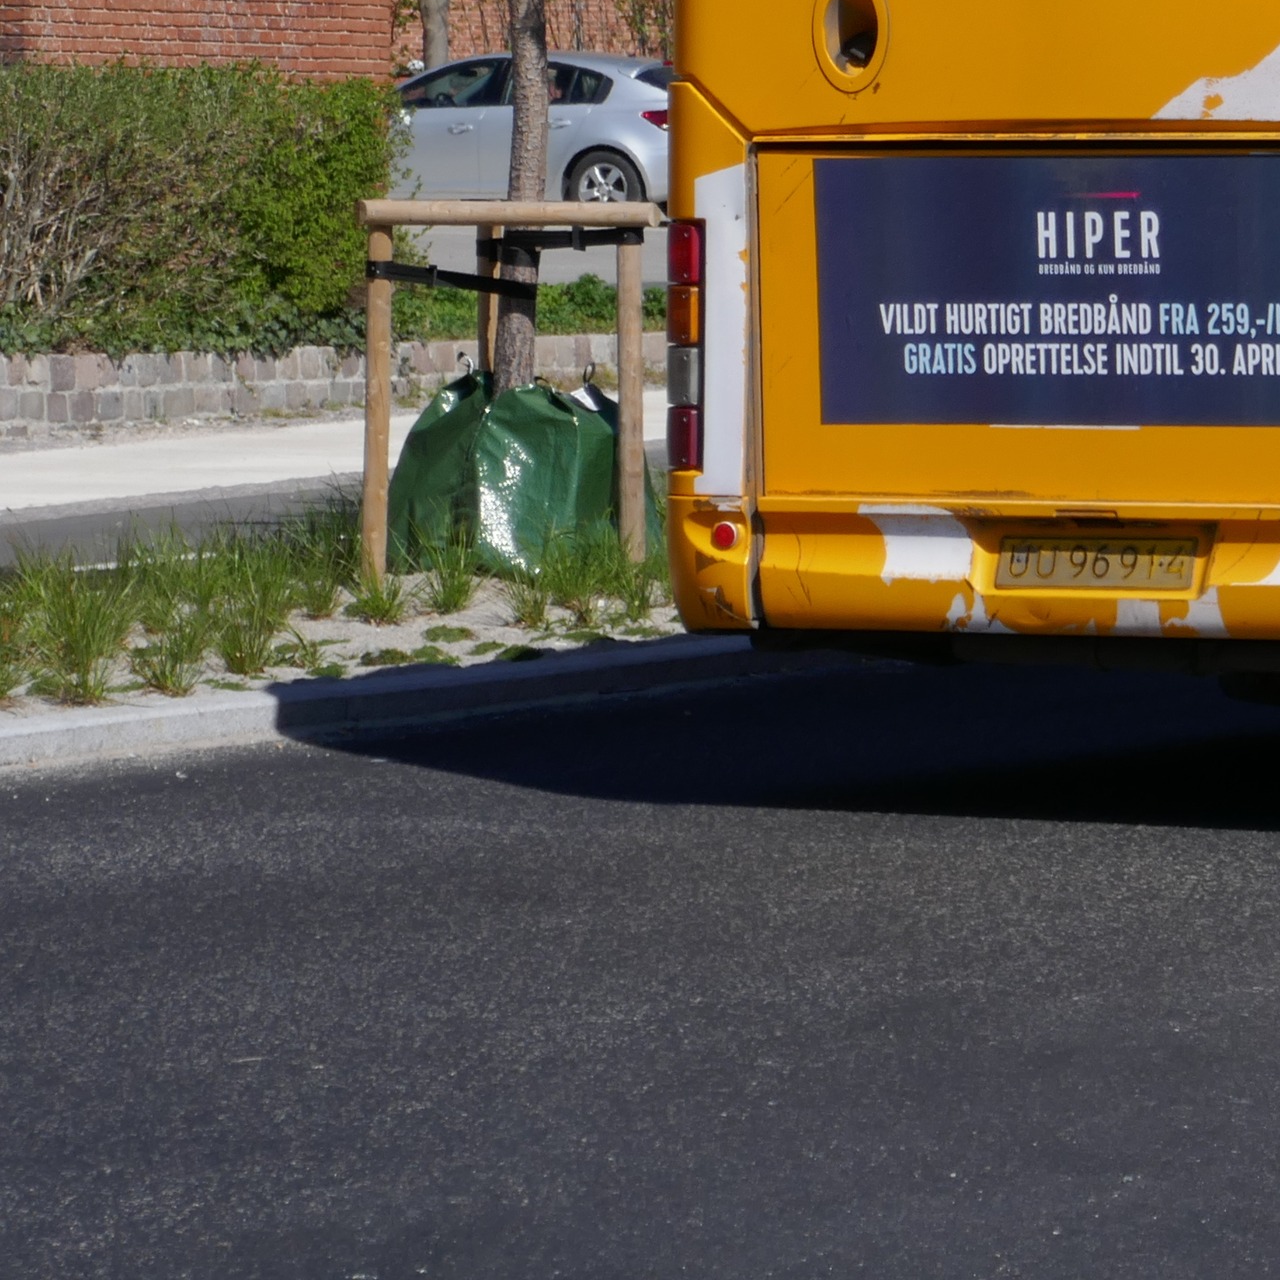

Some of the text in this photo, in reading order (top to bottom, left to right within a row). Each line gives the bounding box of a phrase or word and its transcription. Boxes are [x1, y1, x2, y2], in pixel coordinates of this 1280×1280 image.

[1036, 210, 1161, 259] HIPER
[1038, 261, 1161, 275] BREDBÅND OG KUN BREDBÅND
[879, 303, 939, 335] VILDT
[945, 303, 1032, 335] HURTIGT
[1039, 293, 1151, 335] BREDBÅND
[1159, 303, 1200, 335] FRA
[903, 343, 977, 375] GRATIS
[983, 343, 1108, 375] OPRETTELSE
[1116, 343, 1184, 375] INDTIL
[1190, 343, 1226, 375] 30.
[1069, 544, 1111, 579] 96
